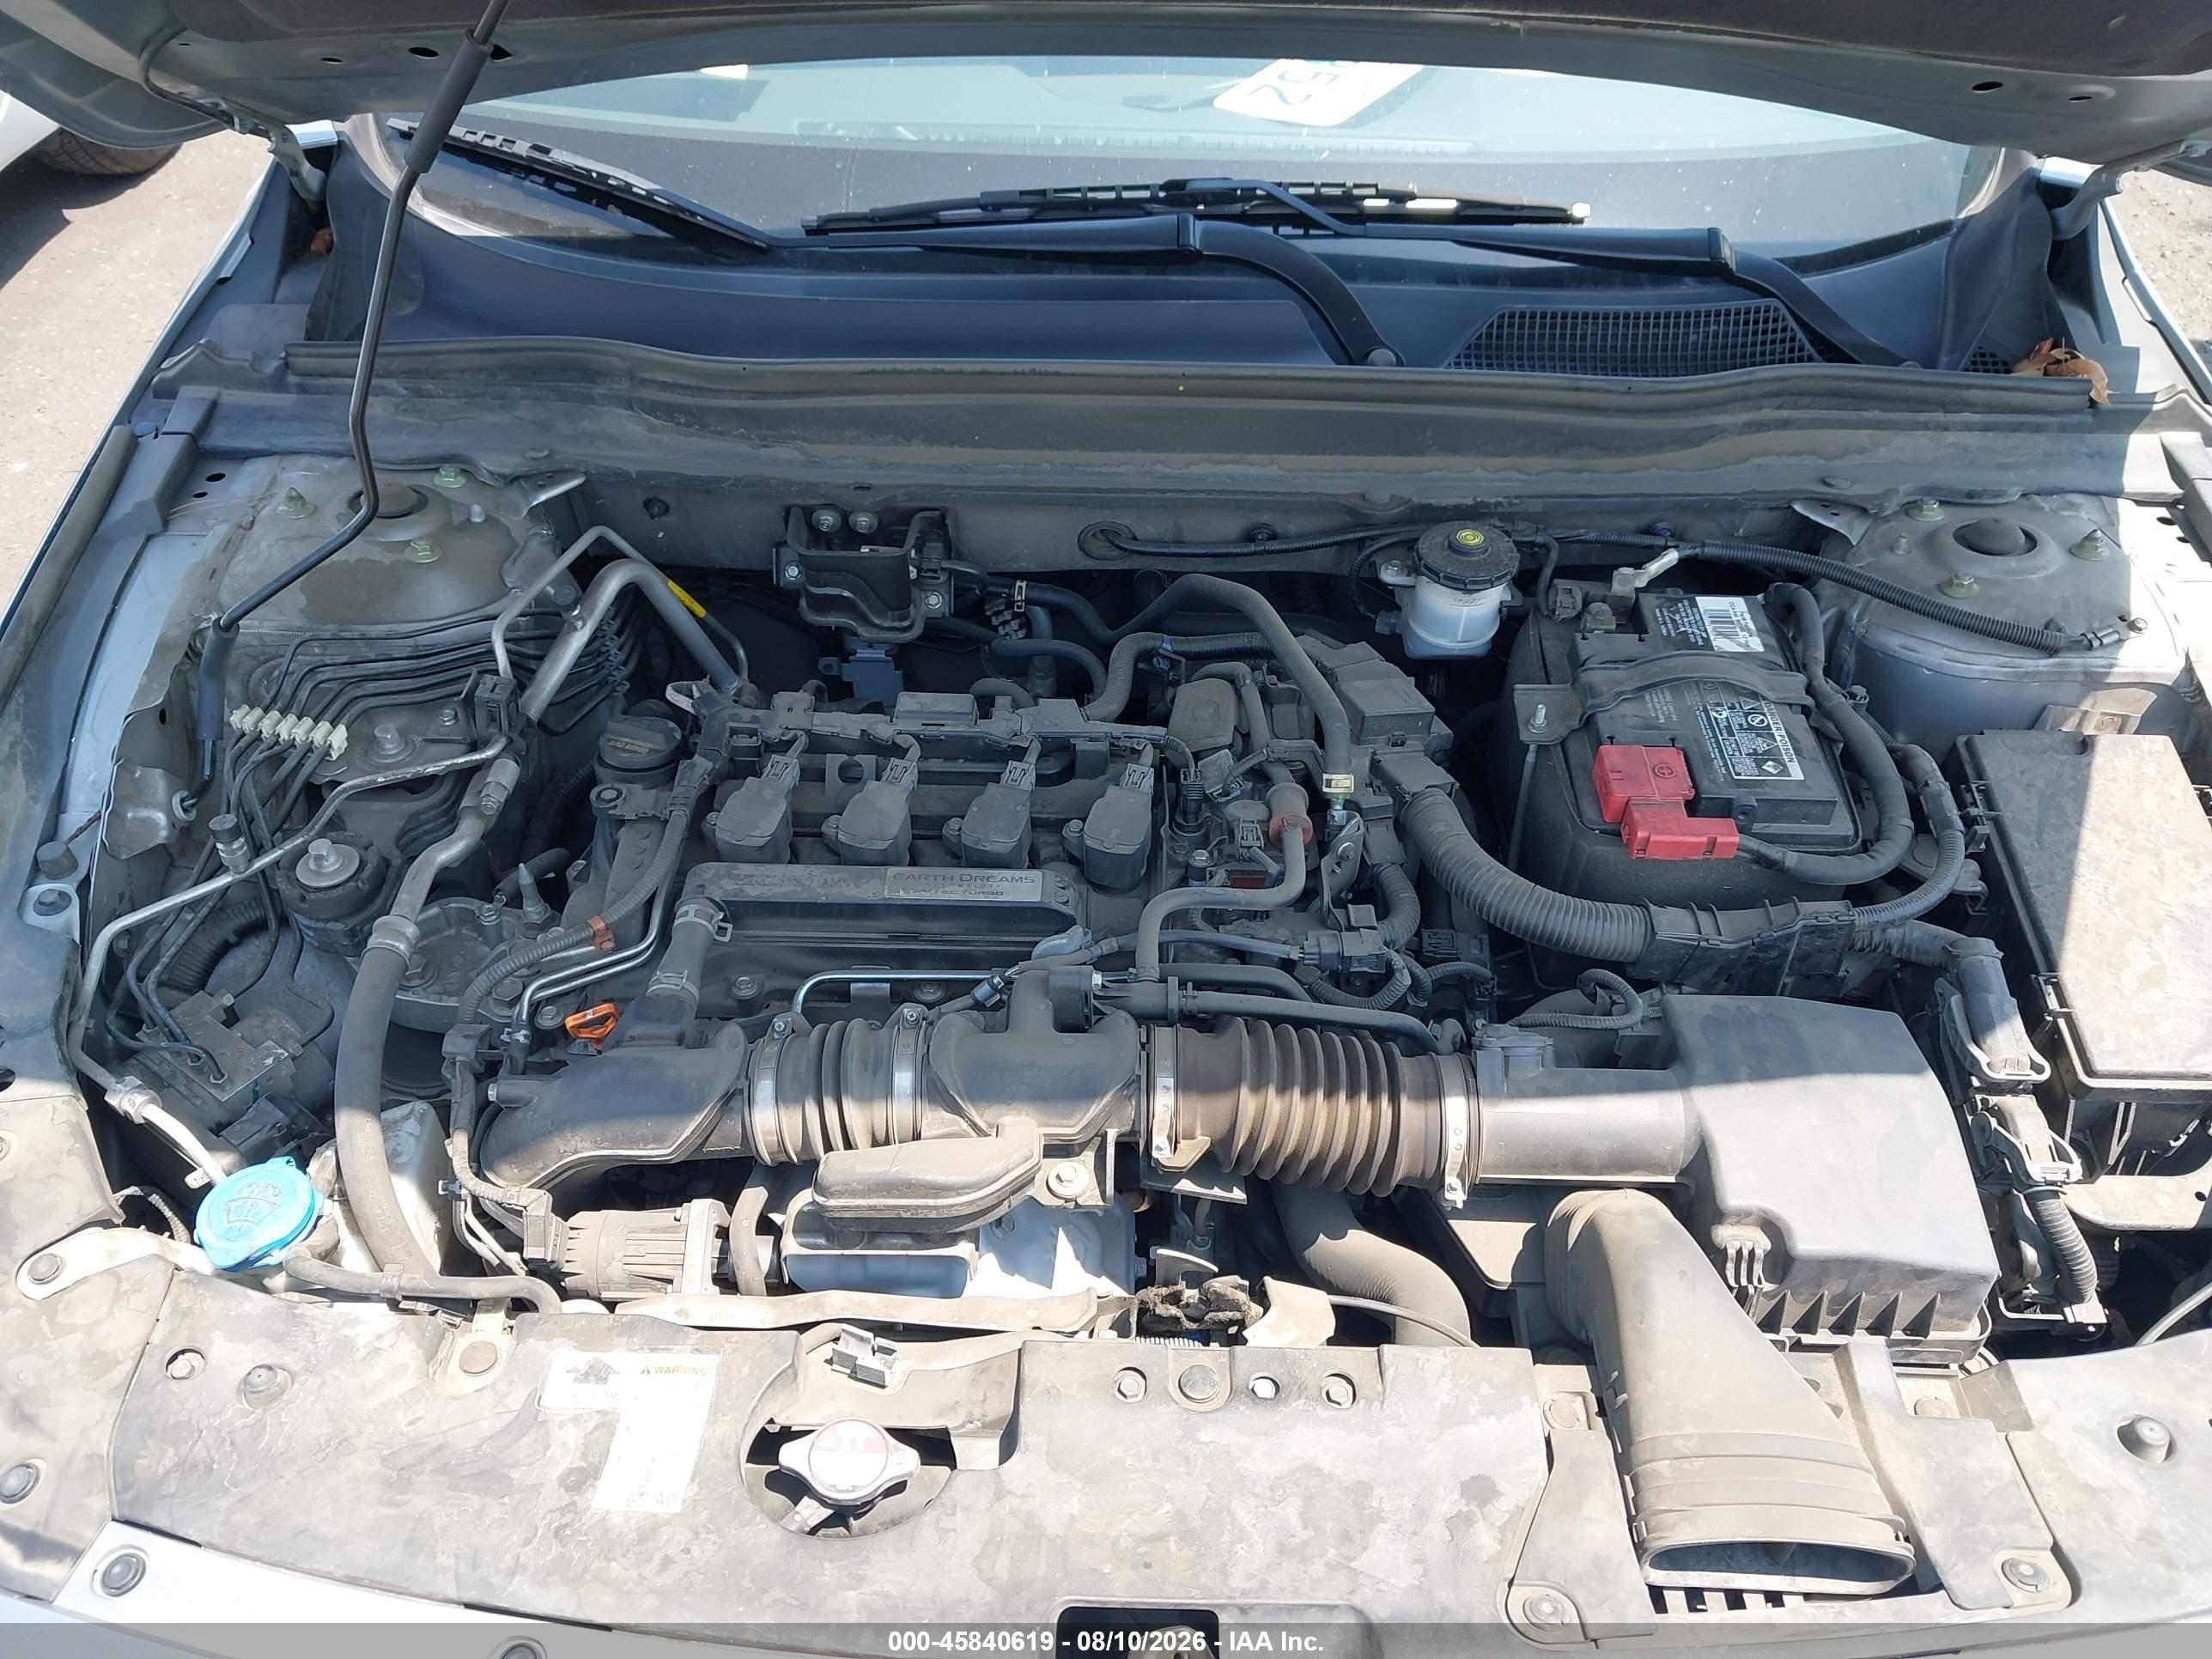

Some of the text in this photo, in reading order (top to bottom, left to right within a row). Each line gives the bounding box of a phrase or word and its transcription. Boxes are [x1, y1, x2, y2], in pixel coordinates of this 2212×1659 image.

[892, 872, 1036, 884] EARTH DREAMS
[653, 1365, 708, 1376] WARNING
